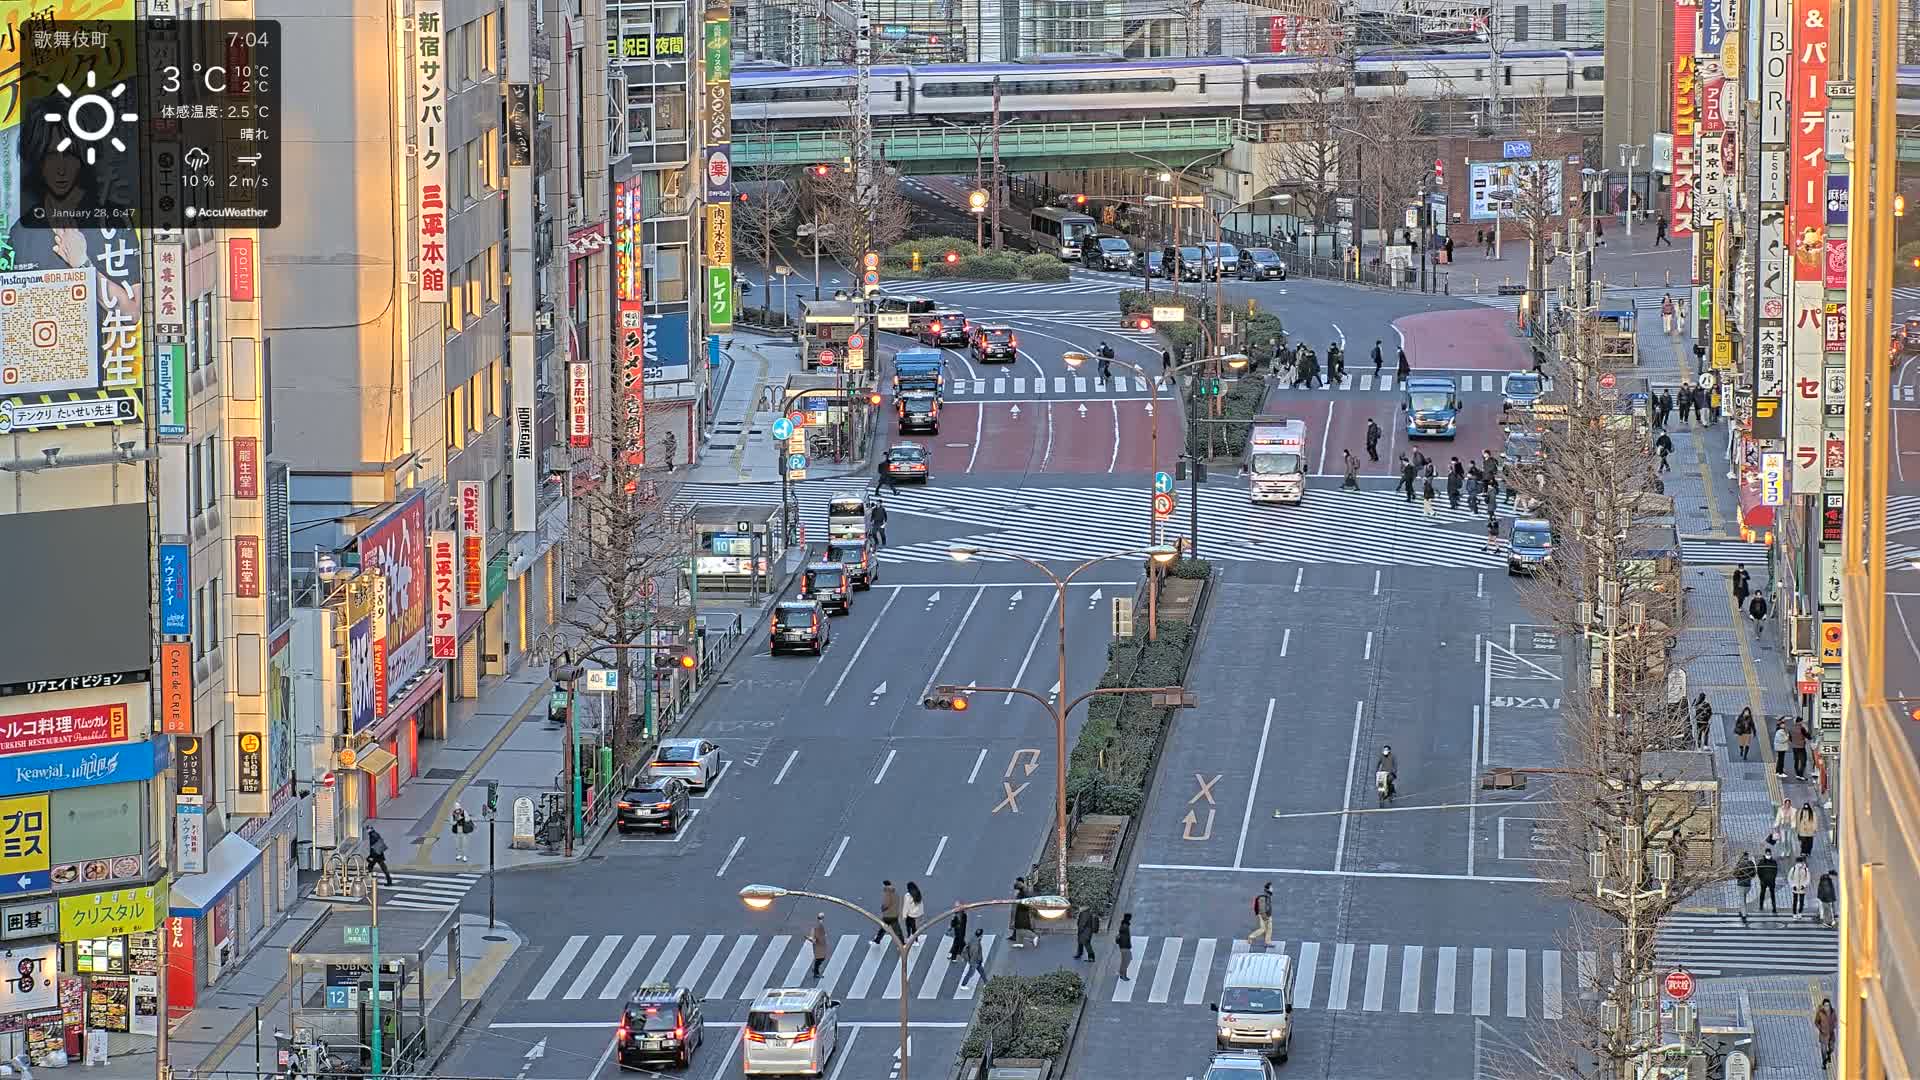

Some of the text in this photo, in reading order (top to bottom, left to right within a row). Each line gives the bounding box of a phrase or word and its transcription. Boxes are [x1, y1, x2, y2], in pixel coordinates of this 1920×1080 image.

[1709, 0, 1720, 45] ントラル
[623, 38, 648, 55] 祝日
[656, 36, 684, 54] 夜間
[1707, 88, 1720, 120] アコム
[418, 12, 445, 291] 新宿サンパーク 三平本館
[1675, 55, 1695, 231] パチンコ エスパス
[1770, 153, 1778, 200] ESOLA
[714, 208, 726, 262] 肉汁水餃子
[713, 276, 727, 313] レイク
[624, 331, 640, 388] ラーメン
[1761, 330, 1774, 381] 大衆酒場
[160, 354, 172, 416] FamilyMart
[1797, 308, 1821, 469] パセラ
[57, 406, 114, 420] たいせい先生
[1830, 405, 1843, 414] 5F
[517, 407, 530, 459] HOMEGAME
[464, 487, 475, 531] GAME
[1829, 497, 1840, 505] 3F
[716, 541, 727, 551] 10
[164, 555, 176, 605] ゲウチャイ
[436, 542, 453, 628] 三平ストア
[0, 742, 26, 751] URKISH
[28, 735, 72, 747] RESTAURANT
[3, 810, 42, 835] プロ
[4, 836, 43, 857] ミス
[8, 912, 42, 932] 囲碁
[72, 903, 145, 927] クリスタル
[329, 991, 345, 1004] 12
